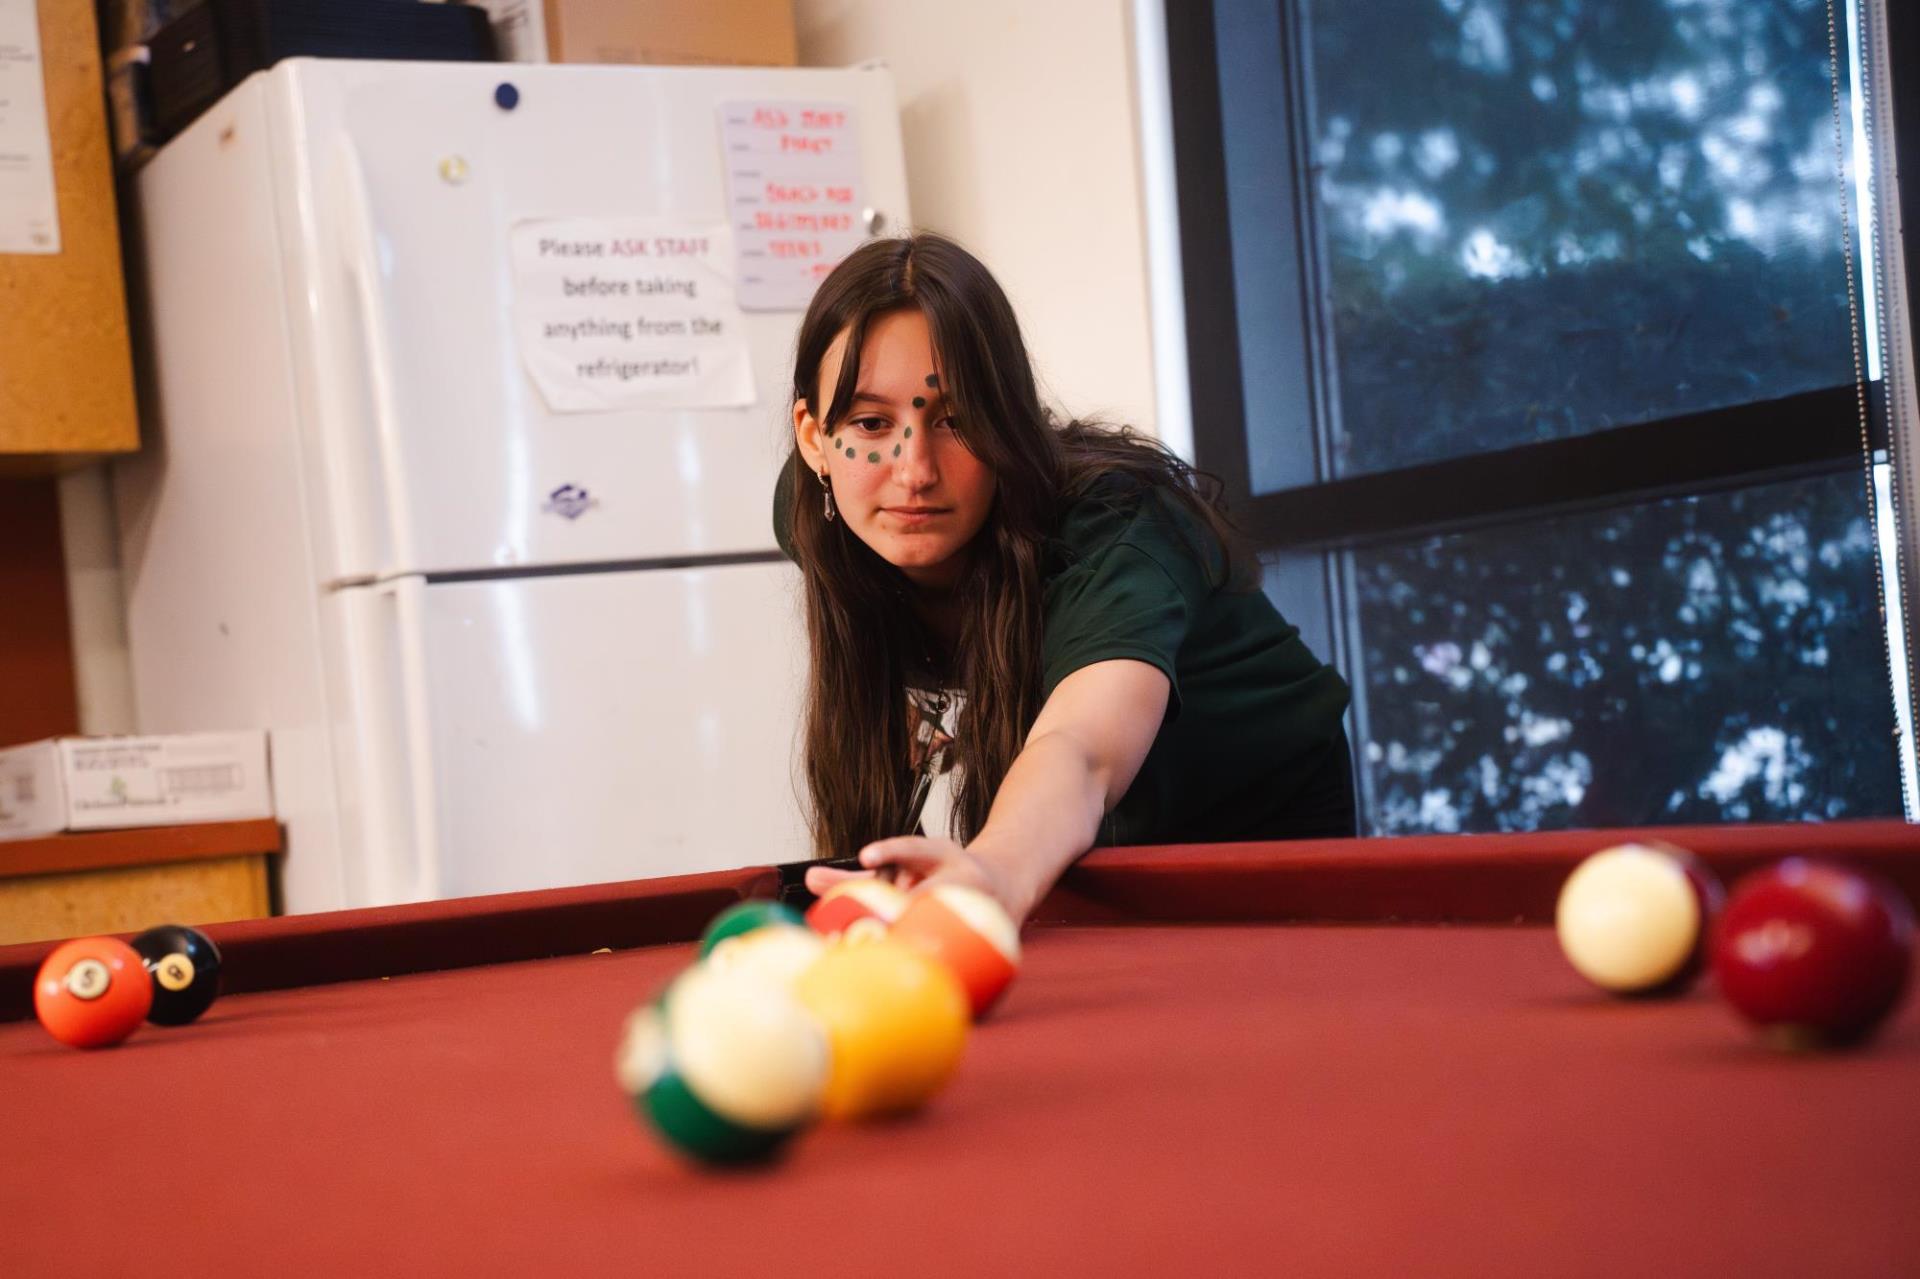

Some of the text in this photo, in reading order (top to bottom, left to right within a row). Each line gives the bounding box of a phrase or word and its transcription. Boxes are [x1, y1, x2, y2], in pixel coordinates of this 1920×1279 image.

[539, 238, 710, 257] Please ASK STAFF
[562, 277, 698, 299] before taking
[543, 317, 723, 341] anything from the
[576, 356, 700, 381] refrigerator!
[167, 964, 186, 982] 8
